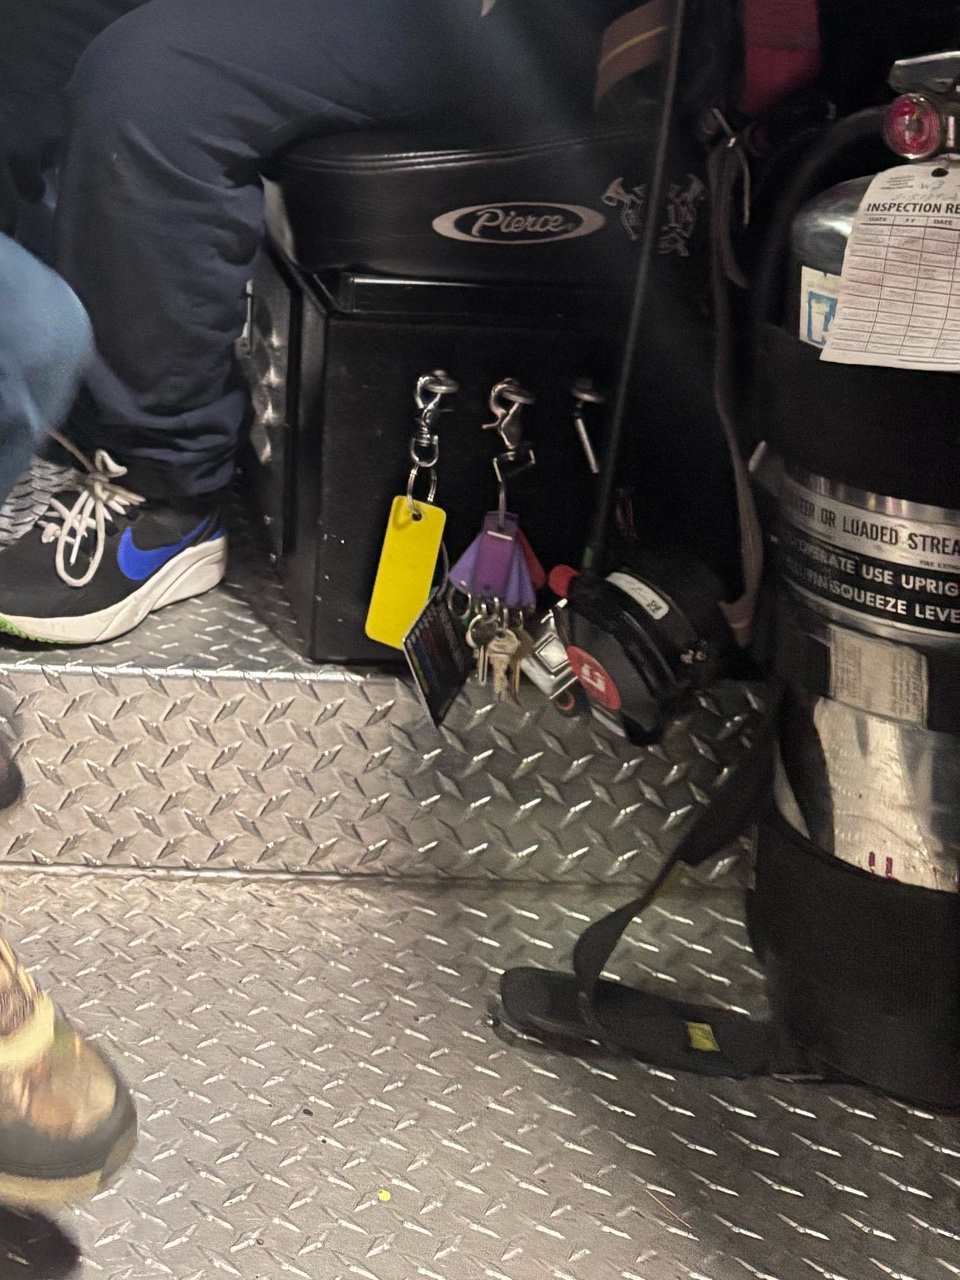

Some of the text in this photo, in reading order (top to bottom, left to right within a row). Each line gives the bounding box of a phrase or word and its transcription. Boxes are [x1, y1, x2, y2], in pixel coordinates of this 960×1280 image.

[472, 208, 565, 237] Pierce
[866, 202, 942, 214] INSPECTION
[821, 507, 836, 527] OR
[862, 564, 894, 585] USE
[900, 574, 960, 597] UPRIG
[832, 581, 907, 615] SQUEEZE
